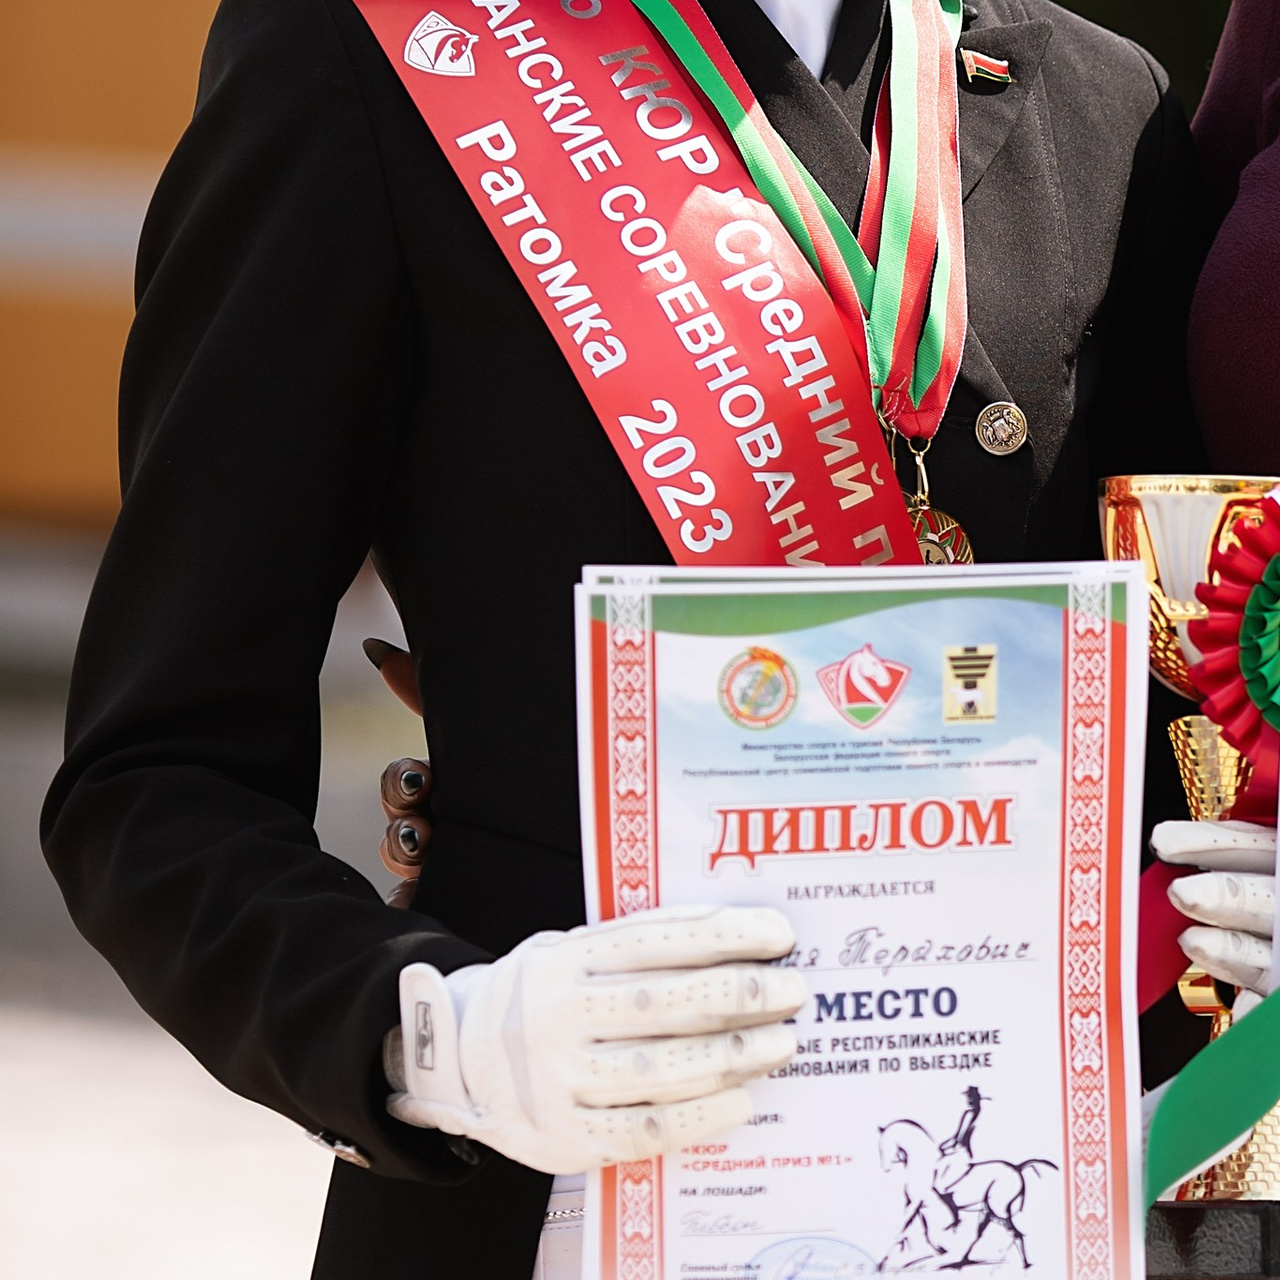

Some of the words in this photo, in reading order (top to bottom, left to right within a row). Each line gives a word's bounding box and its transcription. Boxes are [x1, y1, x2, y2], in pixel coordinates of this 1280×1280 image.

[600, 44, 720, 175] КЮР
[455, 120, 628, 379] Ратомка
[619, 399, 733, 555] 2023
[709, 798, 1013, 871] ДИПЛОМ
[787, 880, 935, 901] НАГРАЖДАЕТСЯ
[814, 987, 958, 1023] МЕСТО
[831, 1029, 1002, 1054] РЕСПУБЛИКАНСКИЕ
[879, 1056, 901, 1072] ПО
[909, 1052, 993, 1071] ВЫЕЗДКЕ
[771, 1156, 812, 1168] ПРИЗ
[679, 1187, 697, 1197] НА
